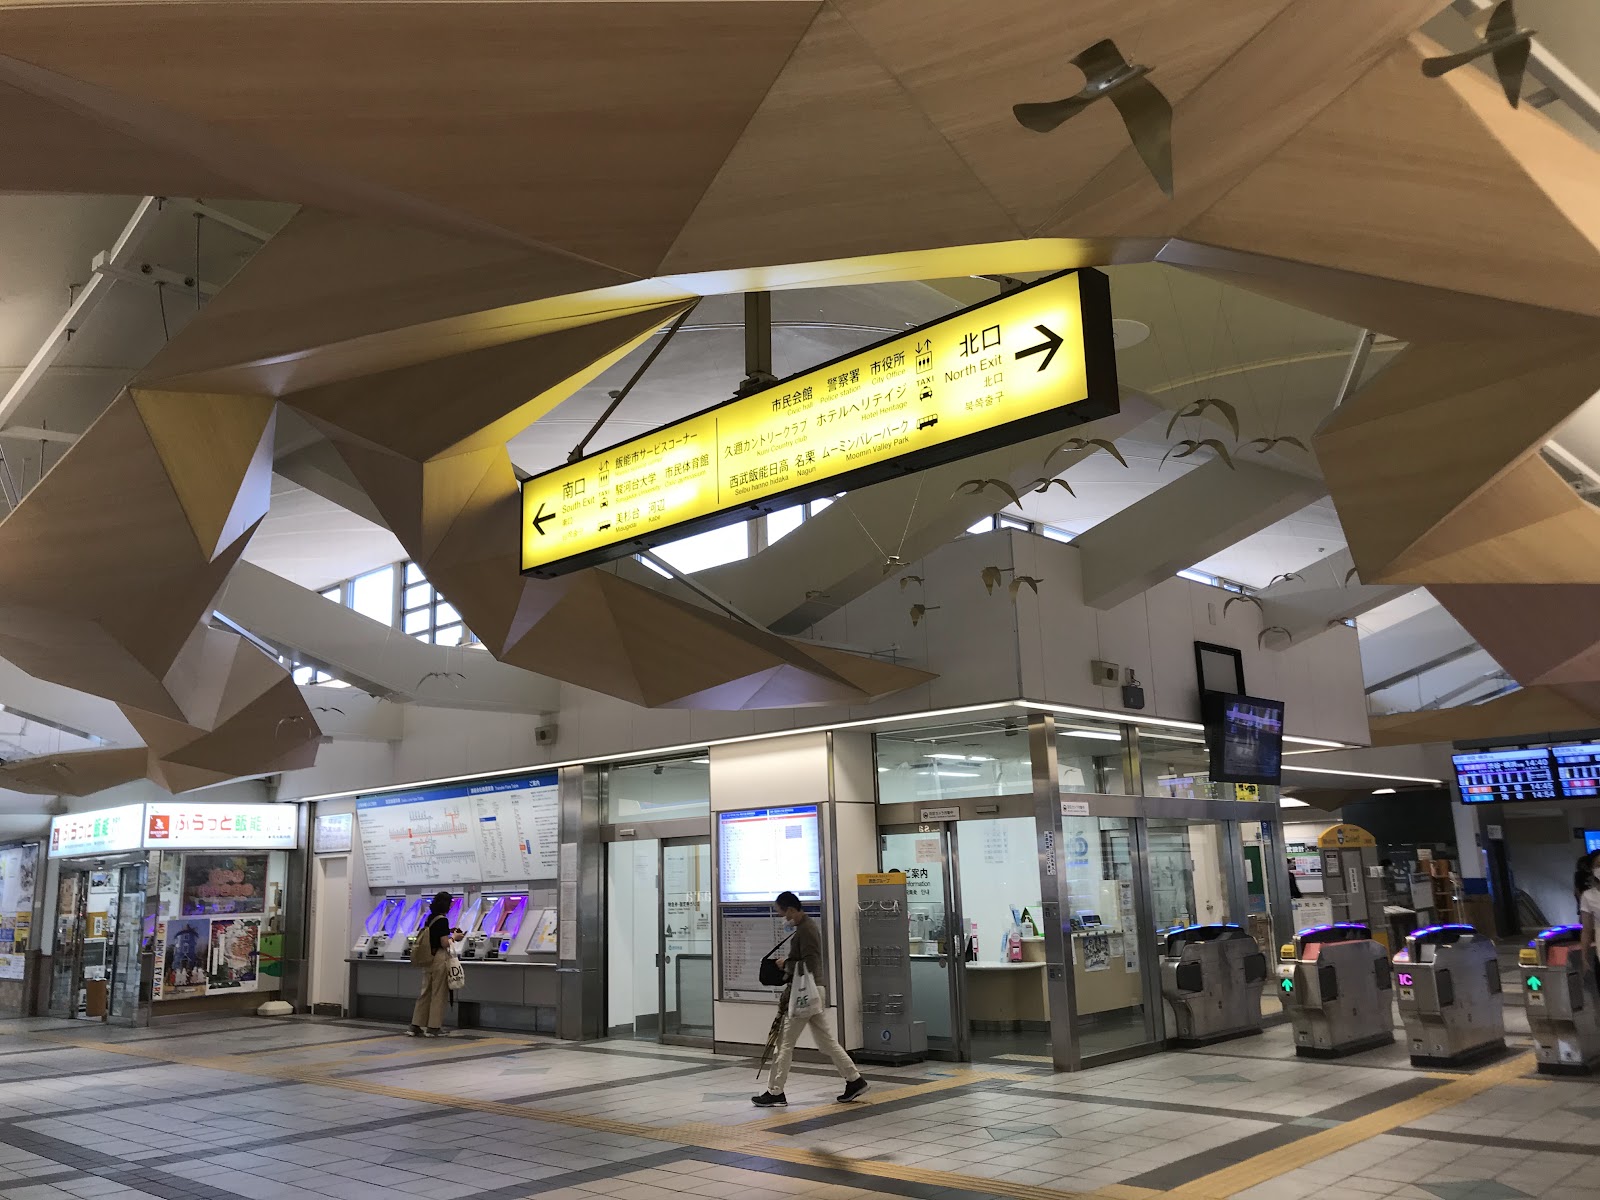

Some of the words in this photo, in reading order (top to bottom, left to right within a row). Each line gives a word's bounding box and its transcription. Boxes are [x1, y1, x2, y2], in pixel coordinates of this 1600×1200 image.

[959, 324, 1001, 357] 北口
[870, 351, 906, 375] 市役所
[944, 364, 977, 384] North
[980, 354, 1003, 371] Exit
[827, 368, 861, 393] 警察署
[871, 375, 885, 386] City
[886, 369, 906, 381] Office
[916, 375, 935, 387] TAXI
[984, 372, 1004, 388] 北口
[772, 386, 813, 413] 市民会館
[817, 382, 908, 427] ホテルヘリテイジ
[820, 391, 839, 404] Police
[840, 384, 861, 398] station
[787, 404, 801, 417] Civic
[802, 401, 814, 412] hall
[861, 409, 879, 422] Hotel
[880, 401, 908, 417] Heritage
[770, 439, 794, 455] Country
[795, 434, 808, 446] club
[822, 420, 910, 459] ムーミンバレーパーク
[846, 448, 871, 462] Moomin
[872, 440, 893, 456] Valley
[893, 435, 910, 448] Park
[615, 433, 698, 469] 飯能市サービスコーナー
[795, 450, 816, 468] 名栗
[665, 454, 709, 479] 市民体育館
[729, 458, 790, 489] 西武飯能日高
[562, 478, 586, 500] 南口
[615, 472, 657, 495] 駿河台大学
[735, 485, 750, 496] Seibu
[751, 481, 768, 492] hanno
[769, 475, 789, 487] hidaka
[562, 501, 581, 514] South
[582, 496, 596, 507] Exit
[648, 499, 666, 515] 河辺
[1525, 758, 1549, 767] 14:40
[1530, 782, 1554, 790] 14:45
[1532, 790, 1556, 799] 14:54
[175, 814, 262, 831] ふらっと飯能
[904, 867, 928, 879] ご案内
[1398, 973, 1413, 985] IC
